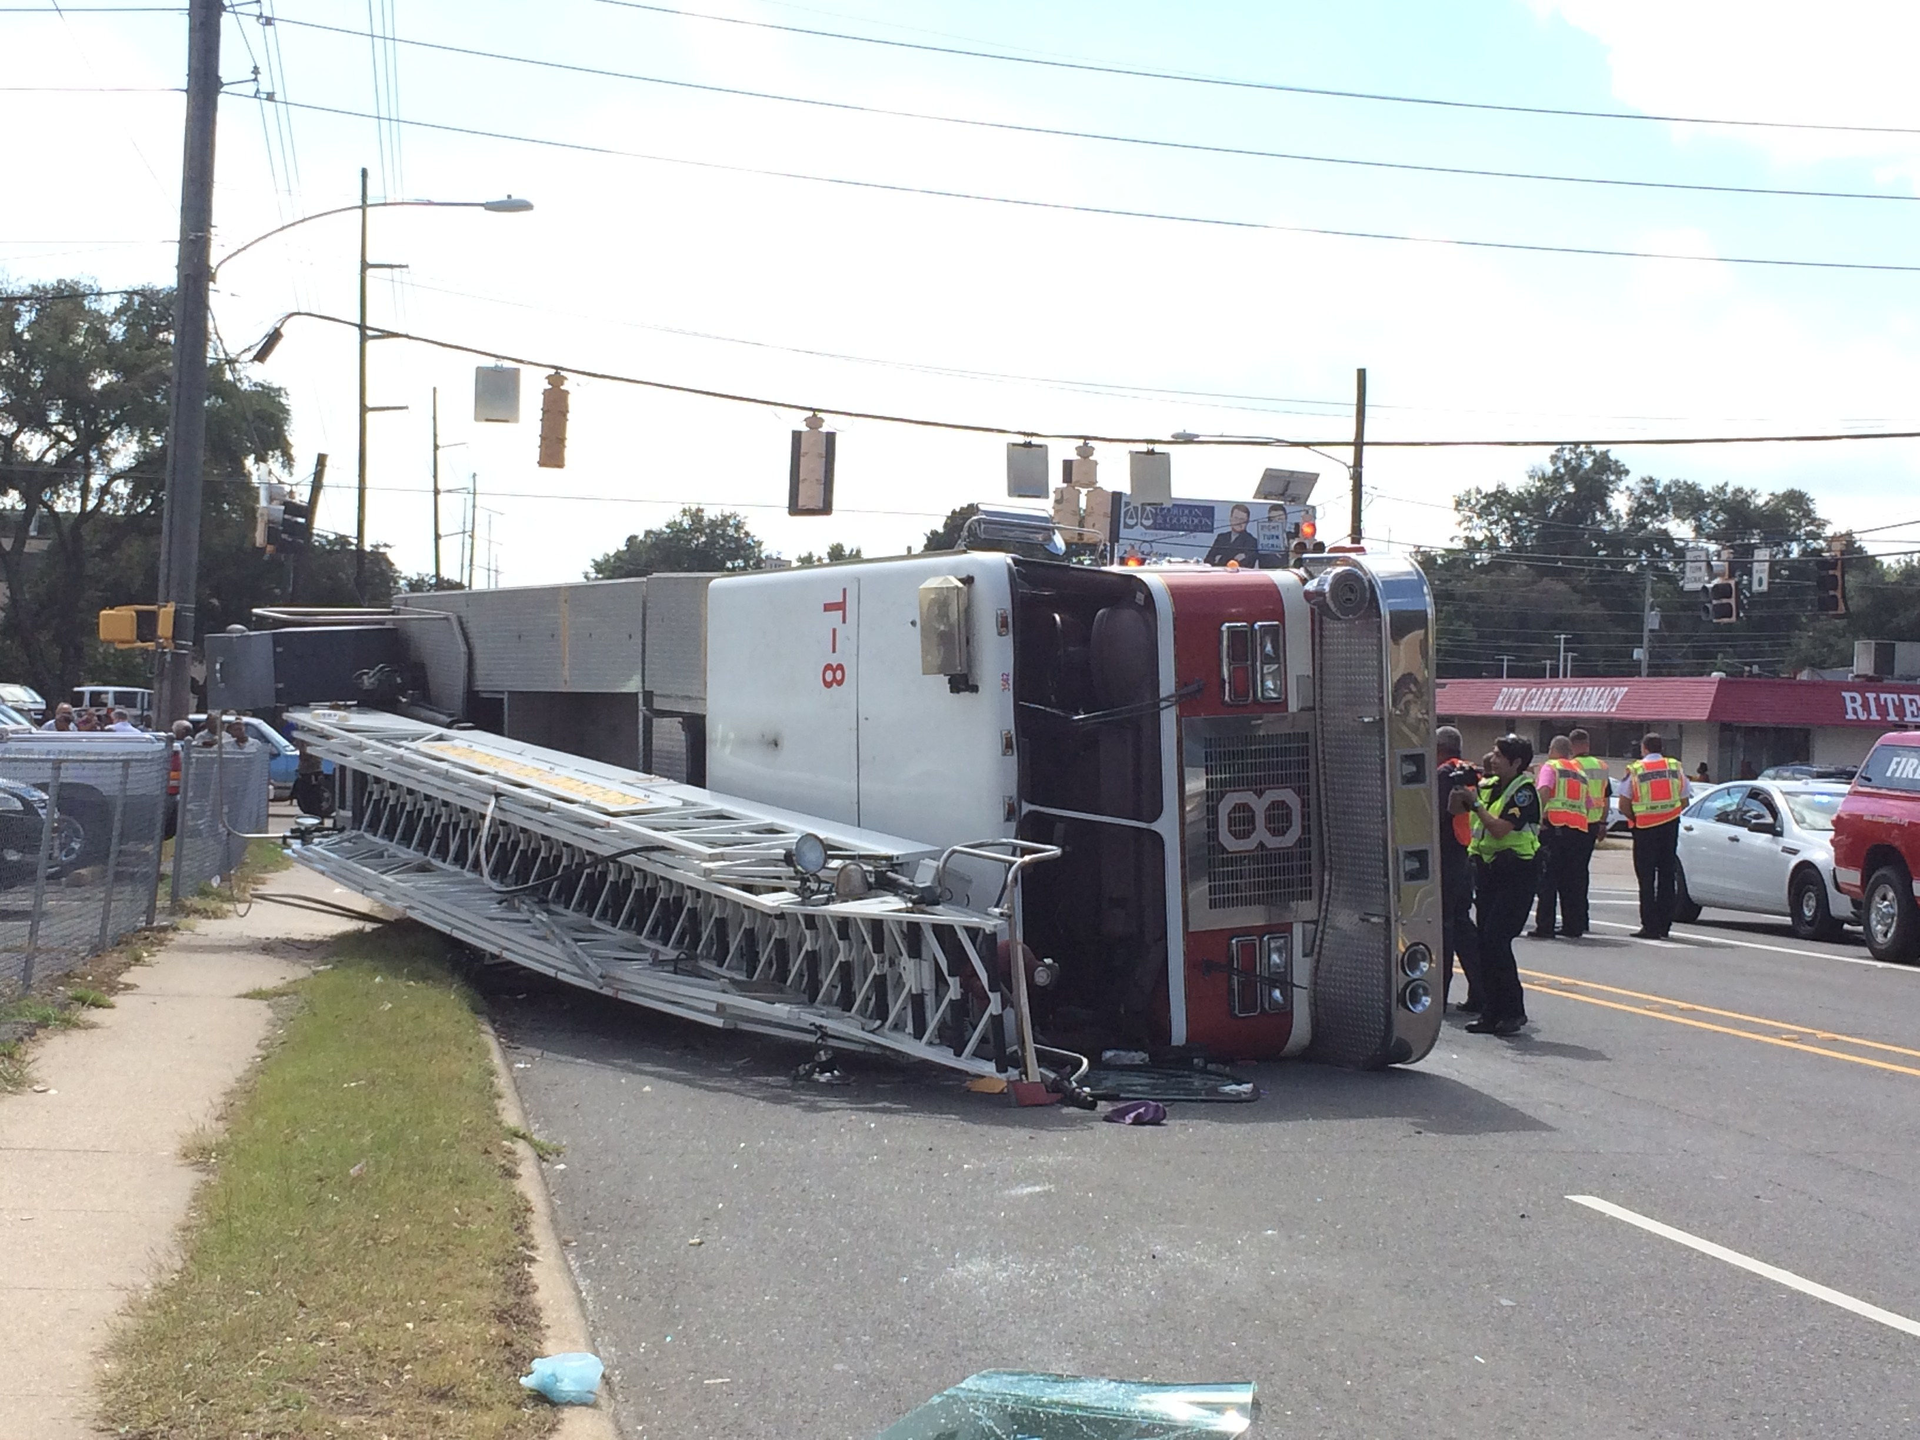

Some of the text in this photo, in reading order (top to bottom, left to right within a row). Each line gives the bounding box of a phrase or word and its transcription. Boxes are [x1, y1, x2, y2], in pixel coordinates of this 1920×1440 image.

[1157, 506, 1203, 516] GORDON
[1166, 516, 1212, 525] GORDON
[1492, 686, 1629, 713] RITE CARE PHARMACY
[1841, 692, 1920, 722] RITE
[1218, 789, 1302, 853] 8
